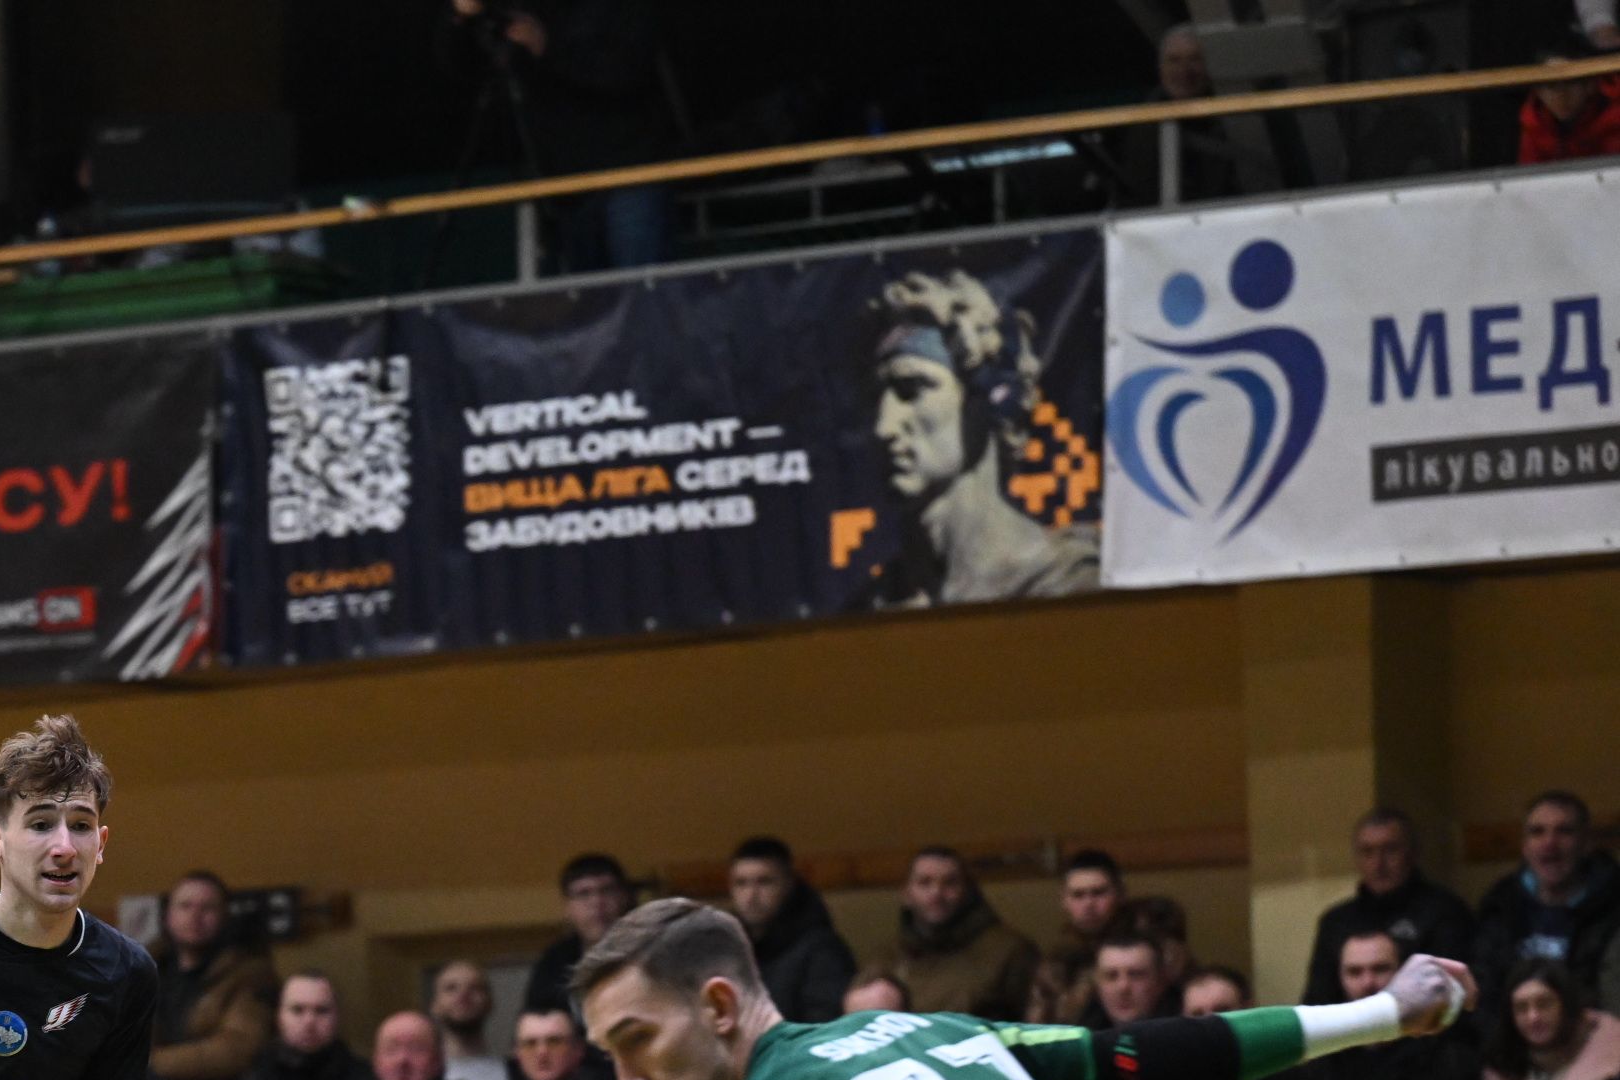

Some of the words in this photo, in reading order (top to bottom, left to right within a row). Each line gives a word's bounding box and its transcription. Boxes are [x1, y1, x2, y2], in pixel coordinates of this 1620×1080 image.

[1370, 295, 1620, 412] МЕД
[463, 389, 648, 437] VERTICAL
[463, 416, 743, 477] DEVELOPMENT
[675, 449, 813, 492] СЕРЕД
